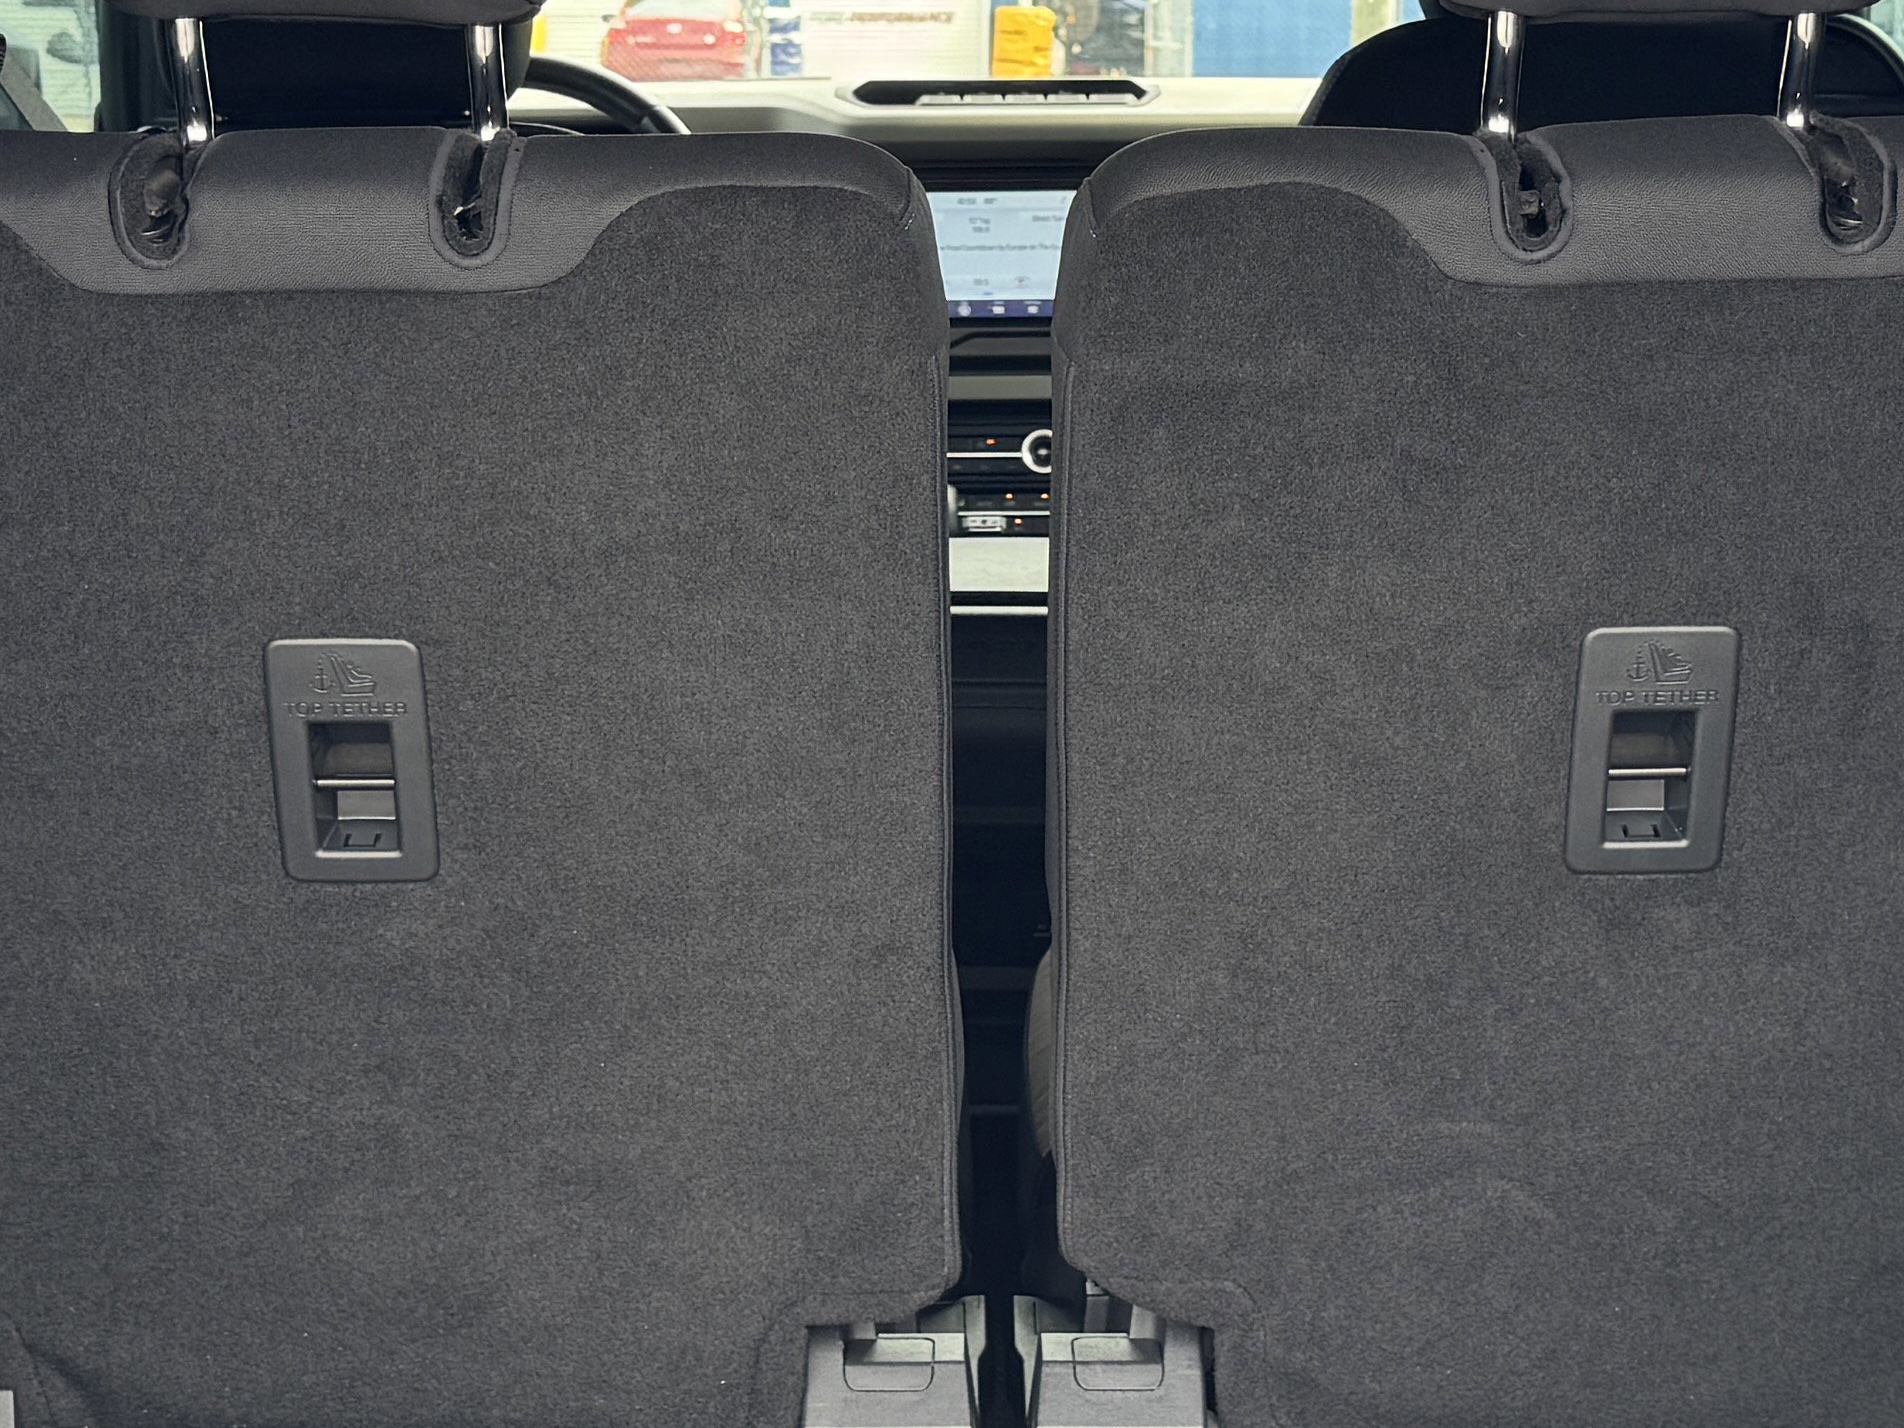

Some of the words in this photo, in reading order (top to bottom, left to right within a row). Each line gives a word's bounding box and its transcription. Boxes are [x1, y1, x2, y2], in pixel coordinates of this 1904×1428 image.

[1596, 689, 1635, 706] TOP
[1642, 688, 1721, 706] TETHER
[283, 701, 322, 718] TOP
[329, 700, 409, 718] TETHER
